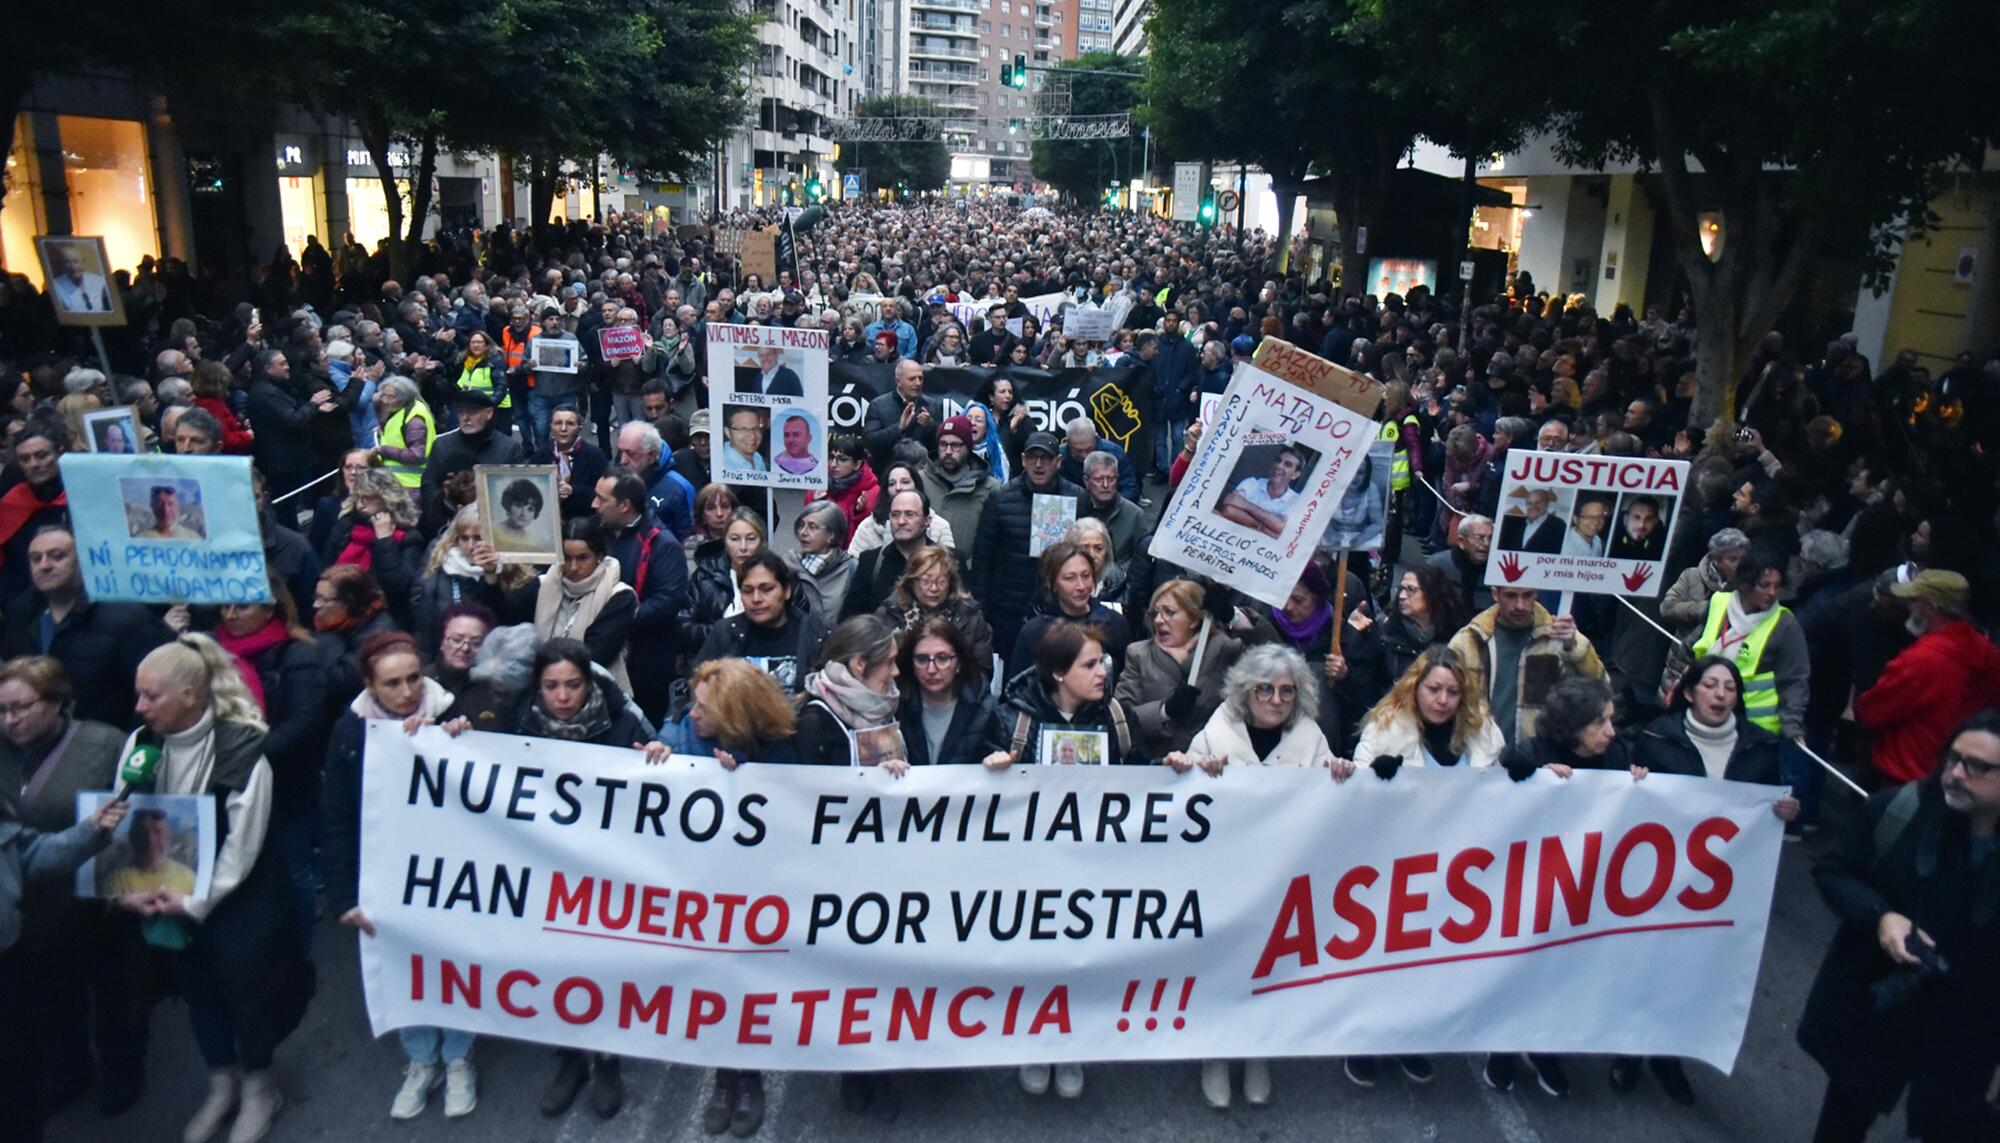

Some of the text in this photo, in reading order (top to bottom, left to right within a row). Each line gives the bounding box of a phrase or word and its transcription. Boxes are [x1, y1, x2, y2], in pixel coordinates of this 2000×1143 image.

[765, 329, 776, 345] de
[1262, 358, 1281, 371] LO
[729, 393, 792, 405] EMETERIO MORA
[1251, 383, 1353, 439] MATADO
[747, 473, 769, 481] MORA
[1511, 456, 1680, 491] JUSTICIA
[124, 545, 263, 573] PERDONAMOS
[1176, 530, 1279, 581] NUESTROS AMADOS
[1256, 546, 1283, 563] CON
[1537, 555, 1617, 569] por mi marido
[1543, 569, 1605, 581] y mis hijos
[407, 754, 1214, 847] NUESTROS FAMILIARES
[402, 854, 1203, 946] HAN MUERTO POR VUESTRA
[1251, 816, 1740, 980] ASESINOS
[411, 953, 1196, 1046] INCOMPETENCIA !!!
